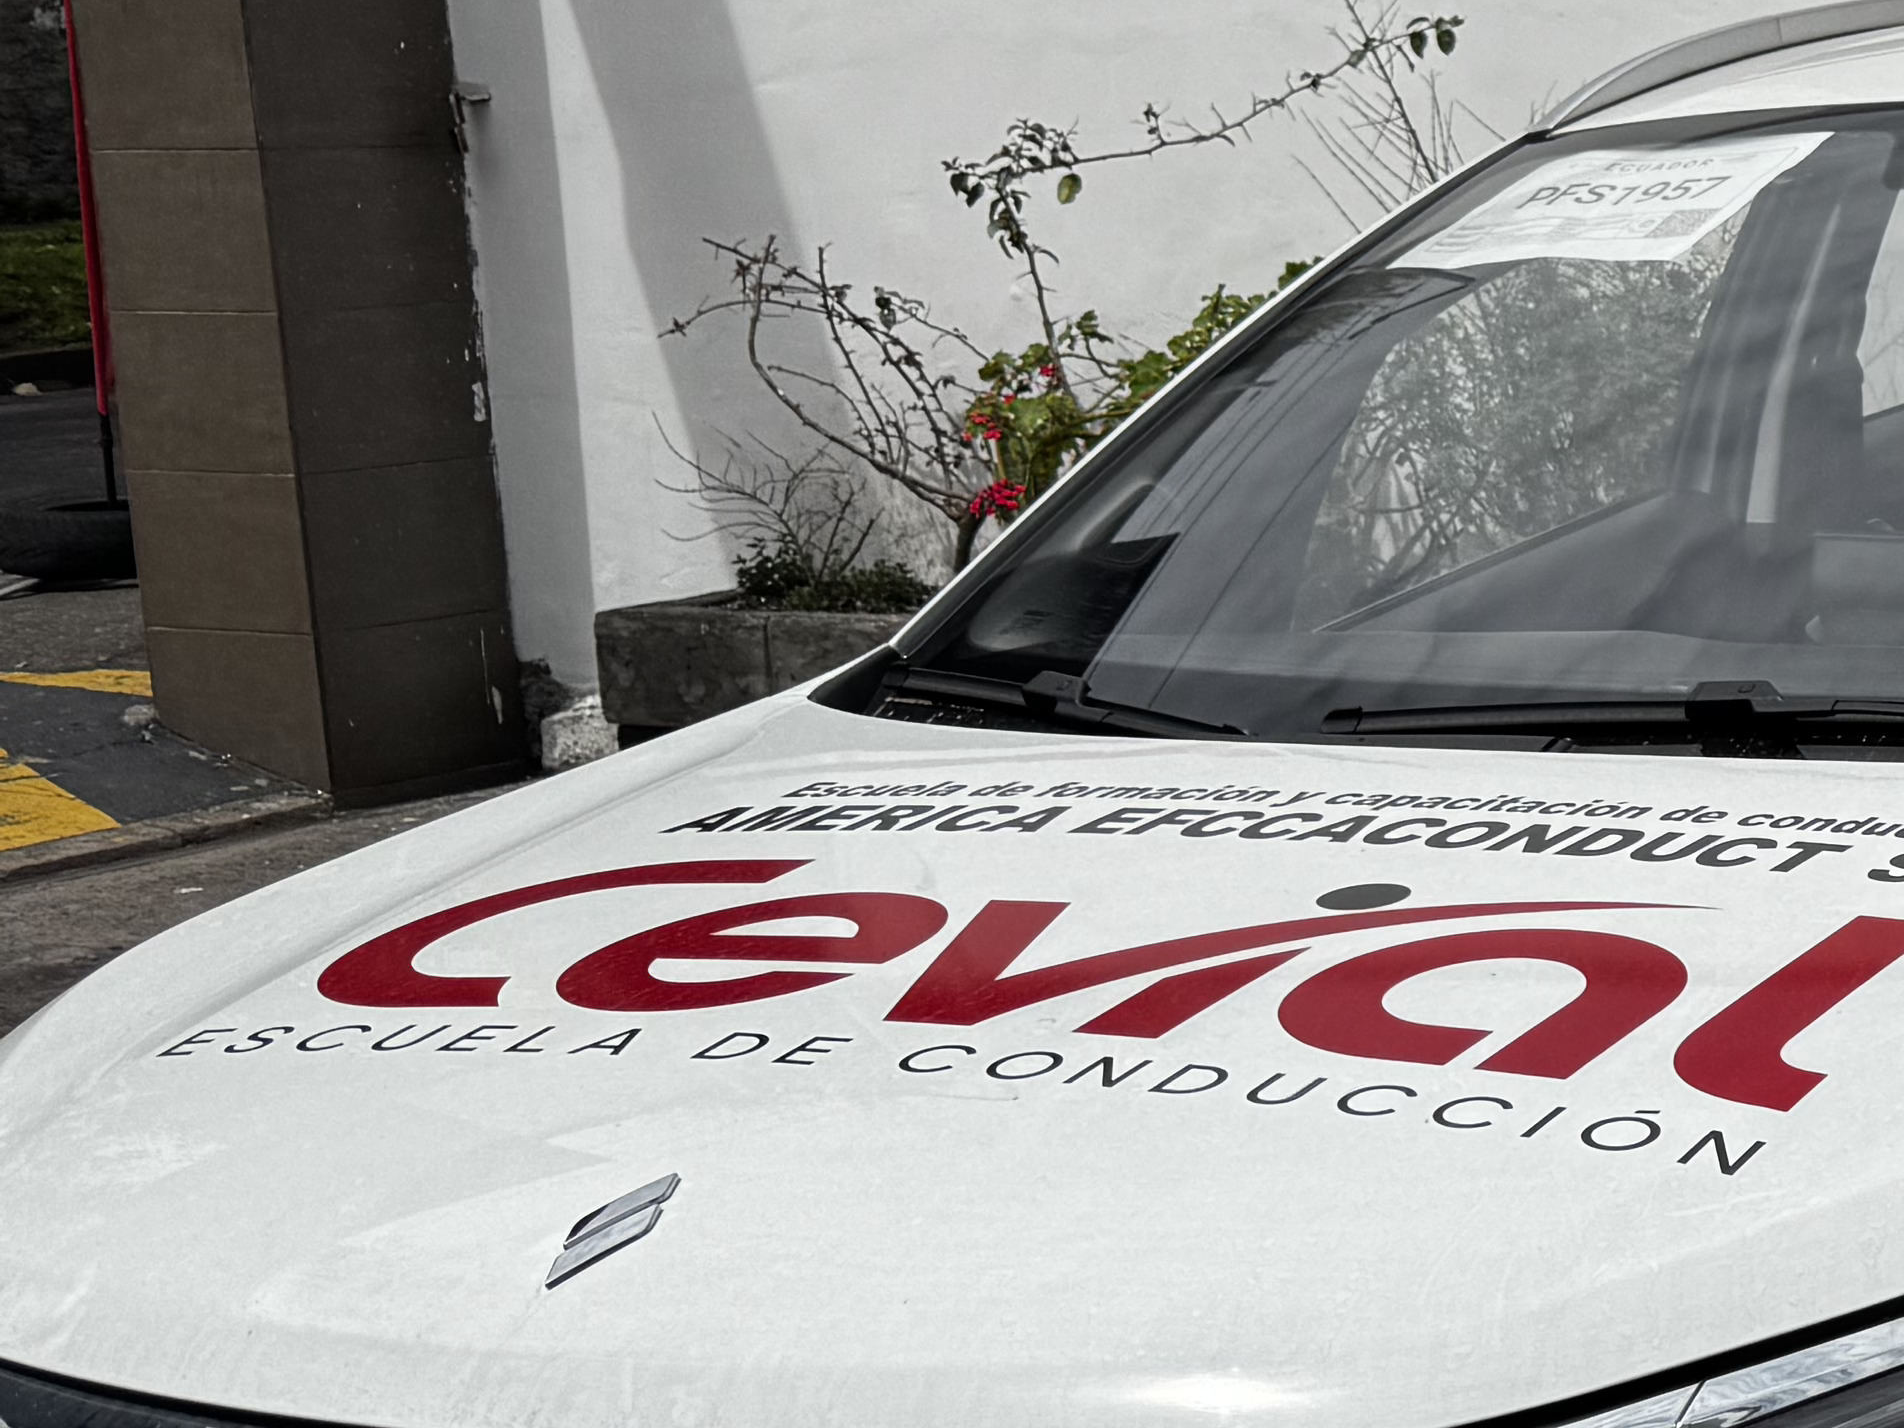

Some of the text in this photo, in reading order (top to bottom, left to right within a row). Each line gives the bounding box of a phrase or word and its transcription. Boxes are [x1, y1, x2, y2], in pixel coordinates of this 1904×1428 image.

[1604, 159, 1715, 173] ECUADOR
[1515, 175, 1733, 210] PFS1957
[780, 781, 953, 799] Escuela
[966, 782, 1036, 797] de
[1033, 782, 1291, 804] formación
[1282, 789, 1323, 807] y
[1326, 791, 1659, 820] capacitación
[1658, 801, 1729, 824] de
[658, 805, 1073, 834] AMERICA
[1066, 806, 1852, 873] EFCCACONDUCT
[154, 1023, 1767, 1176] ESCUELA DE CONDUCCIÓN
